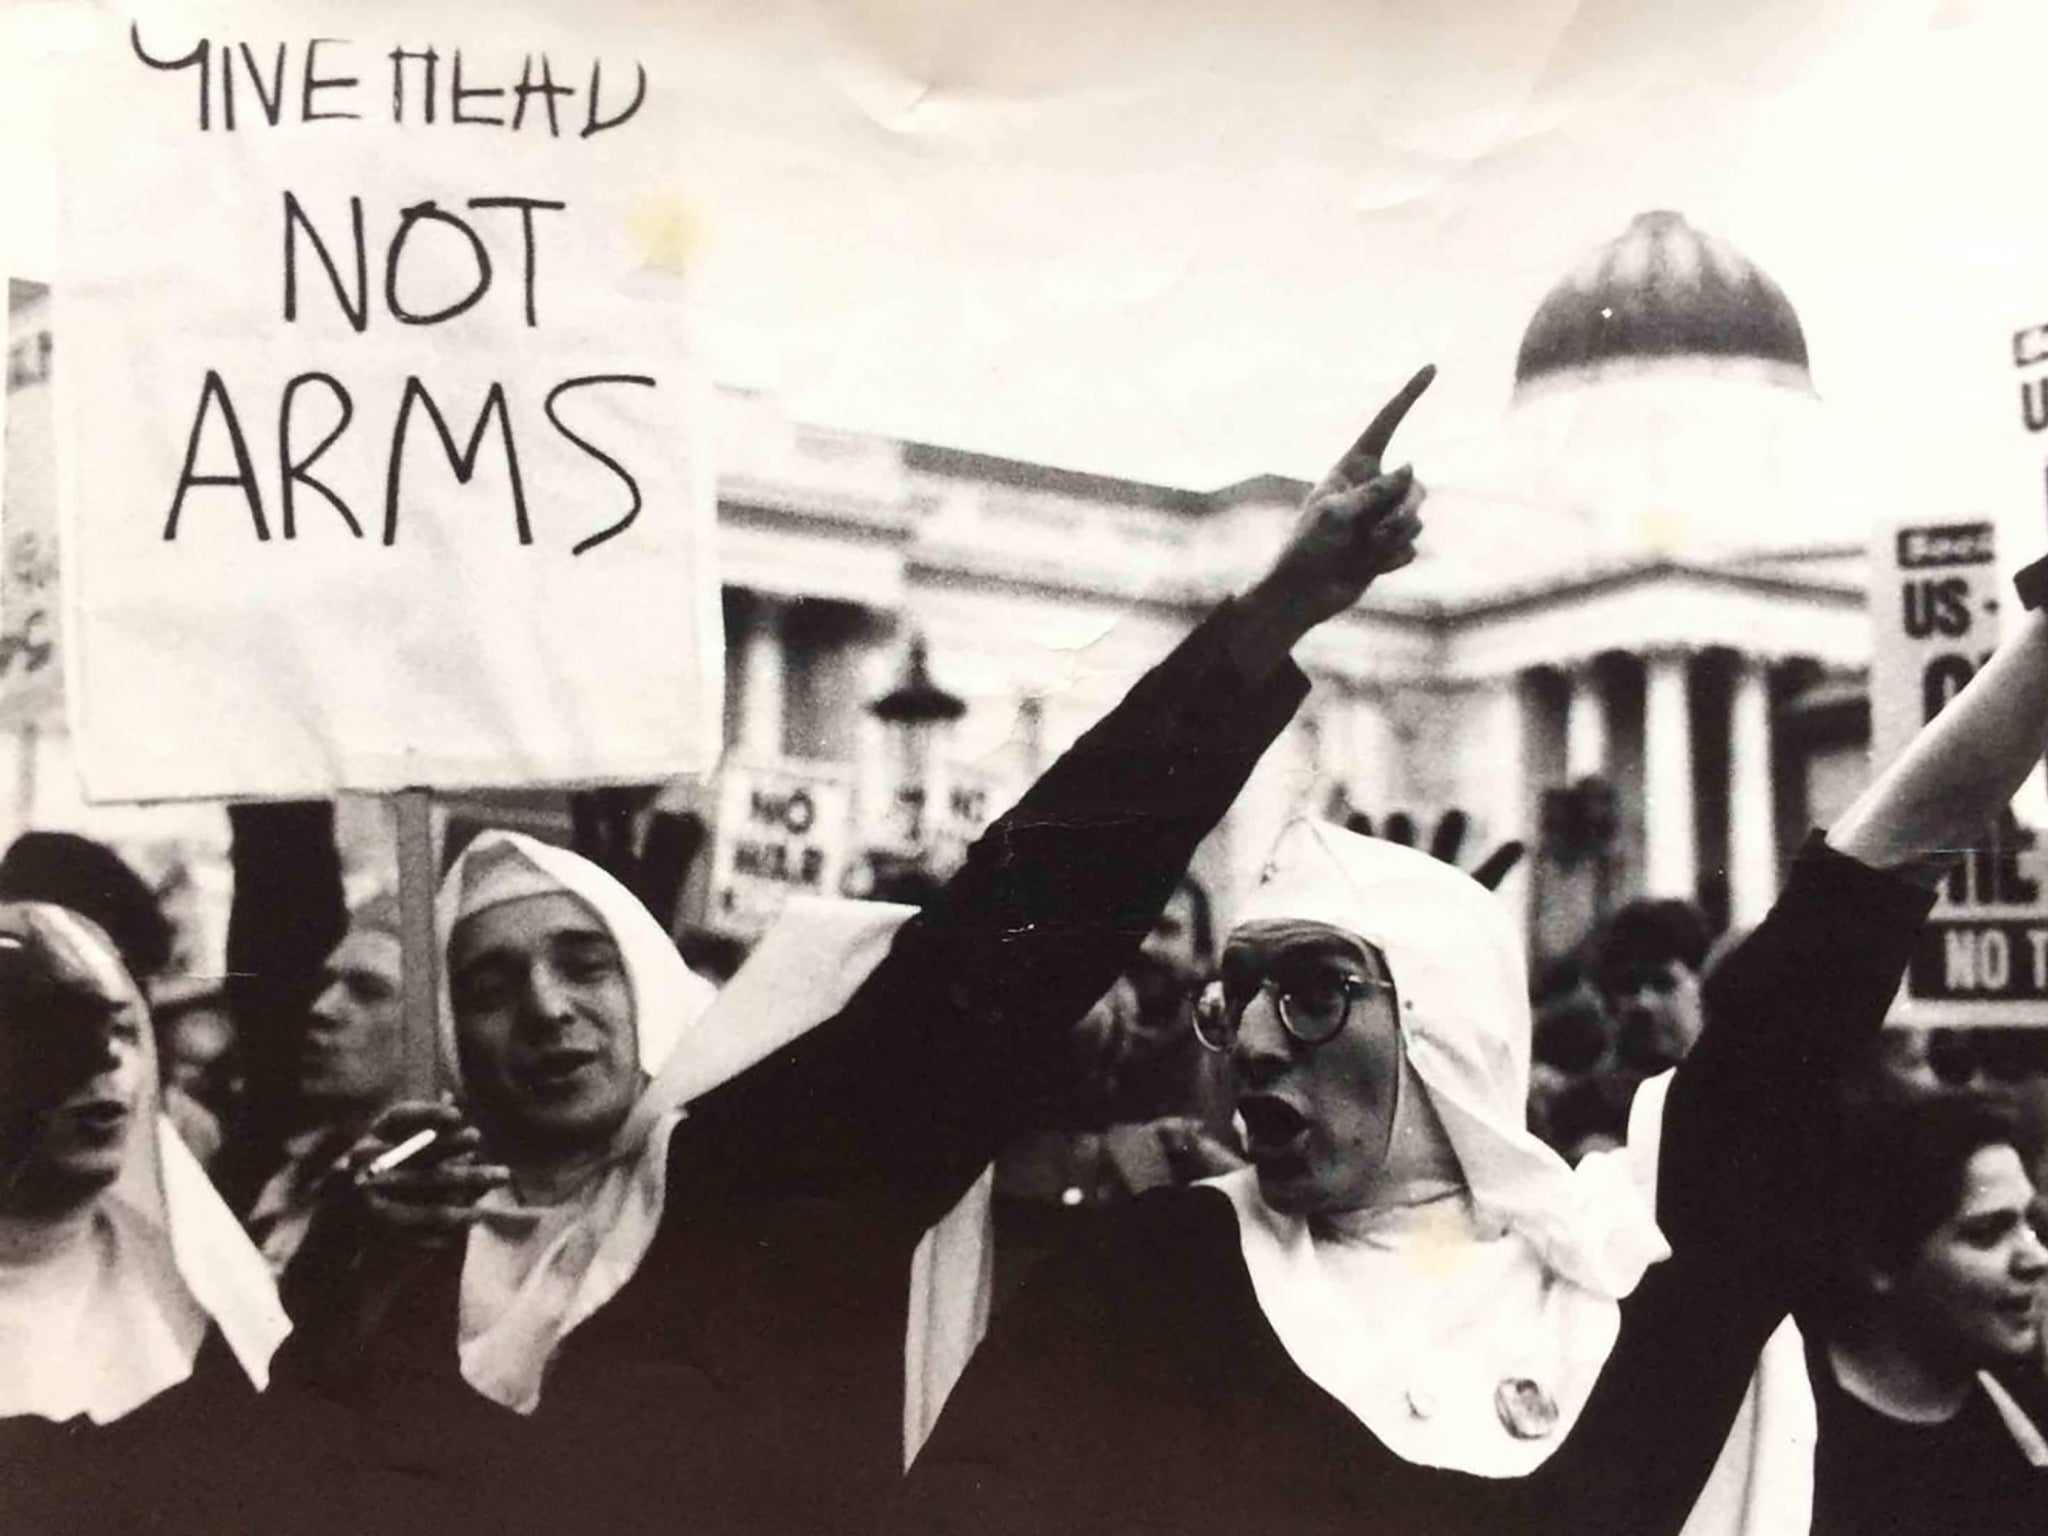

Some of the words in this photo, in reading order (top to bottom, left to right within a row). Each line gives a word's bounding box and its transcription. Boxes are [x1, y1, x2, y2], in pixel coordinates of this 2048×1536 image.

[284, 191, 565, 332] NOT
[164, 371, 655, 555] ARMS
[752, 789, 813, 835] NO
[1946, 930, 2008, 988] NO
